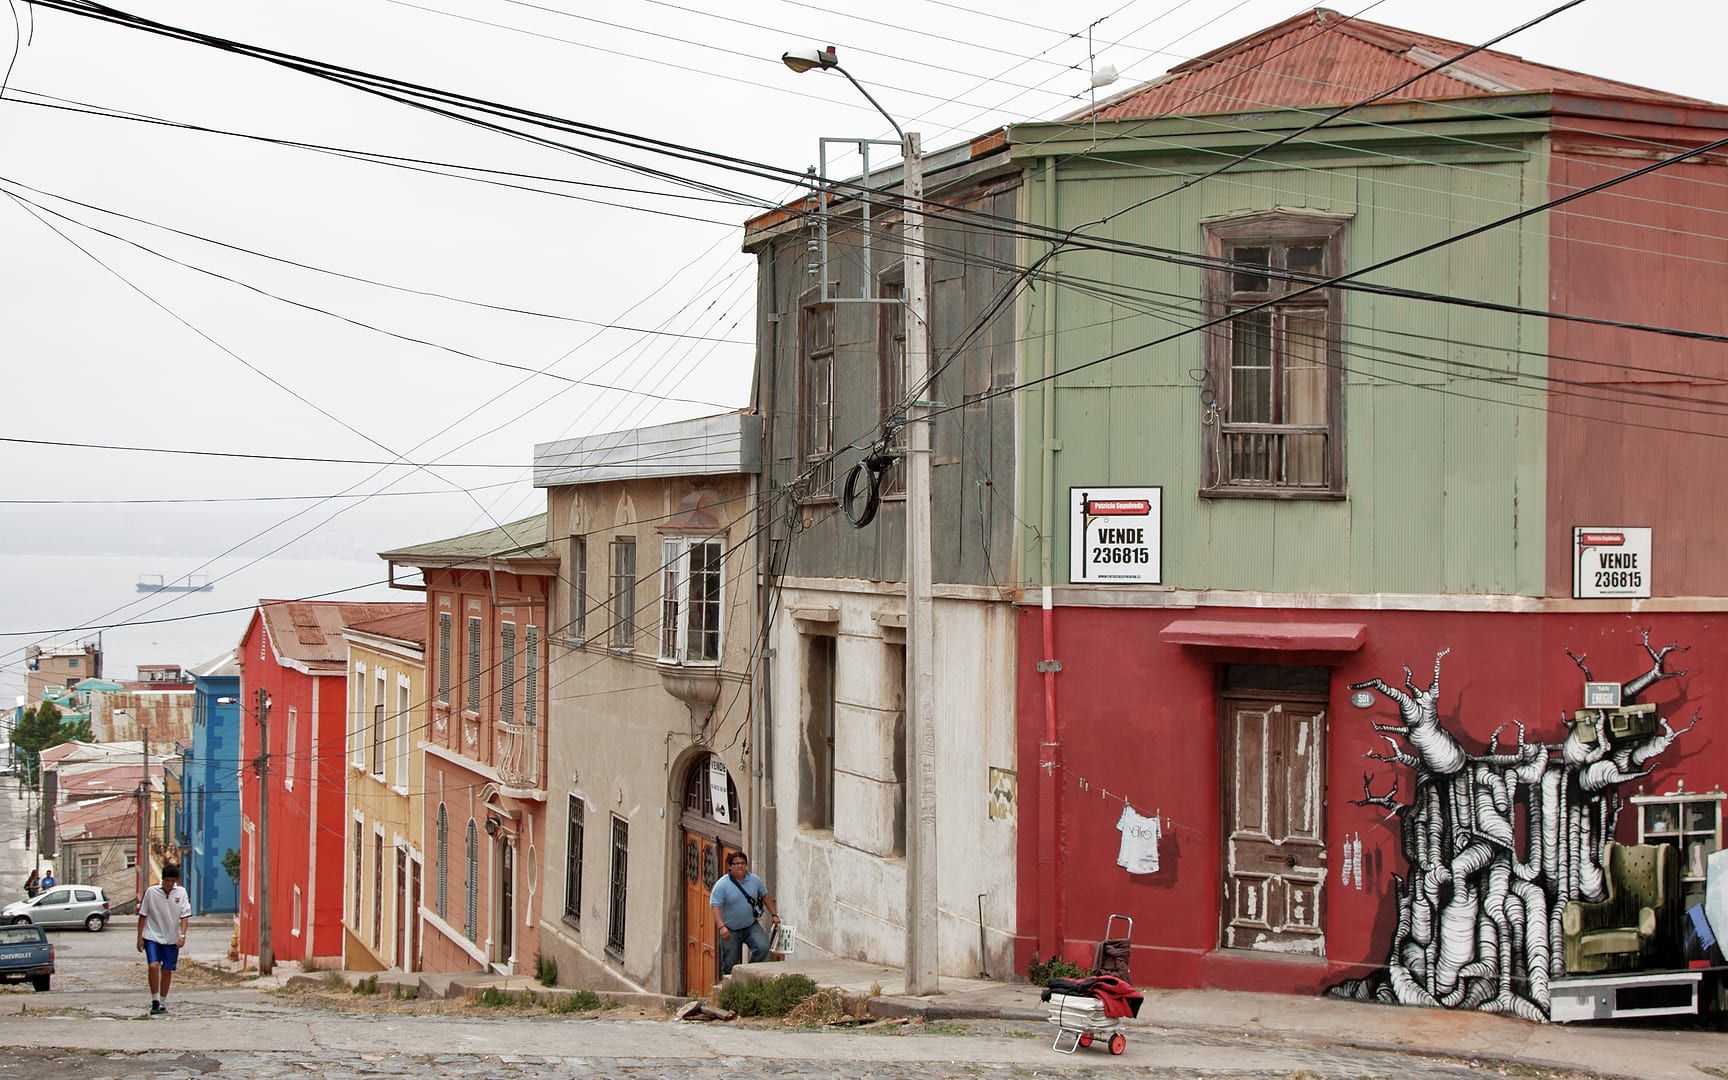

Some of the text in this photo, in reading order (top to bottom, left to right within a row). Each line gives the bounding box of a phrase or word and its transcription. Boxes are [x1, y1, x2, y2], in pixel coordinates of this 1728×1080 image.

[1098, 528, 1144, 544] VENDE
[1093, 547, 1149, 563] 236815
[1600, 553, 1638, 569] VENDE
[1595, 571, 1642, 587] 236815
[711, 760, 726, 773] VENDE
[0, 952, 32, 960] CHEVROLET
